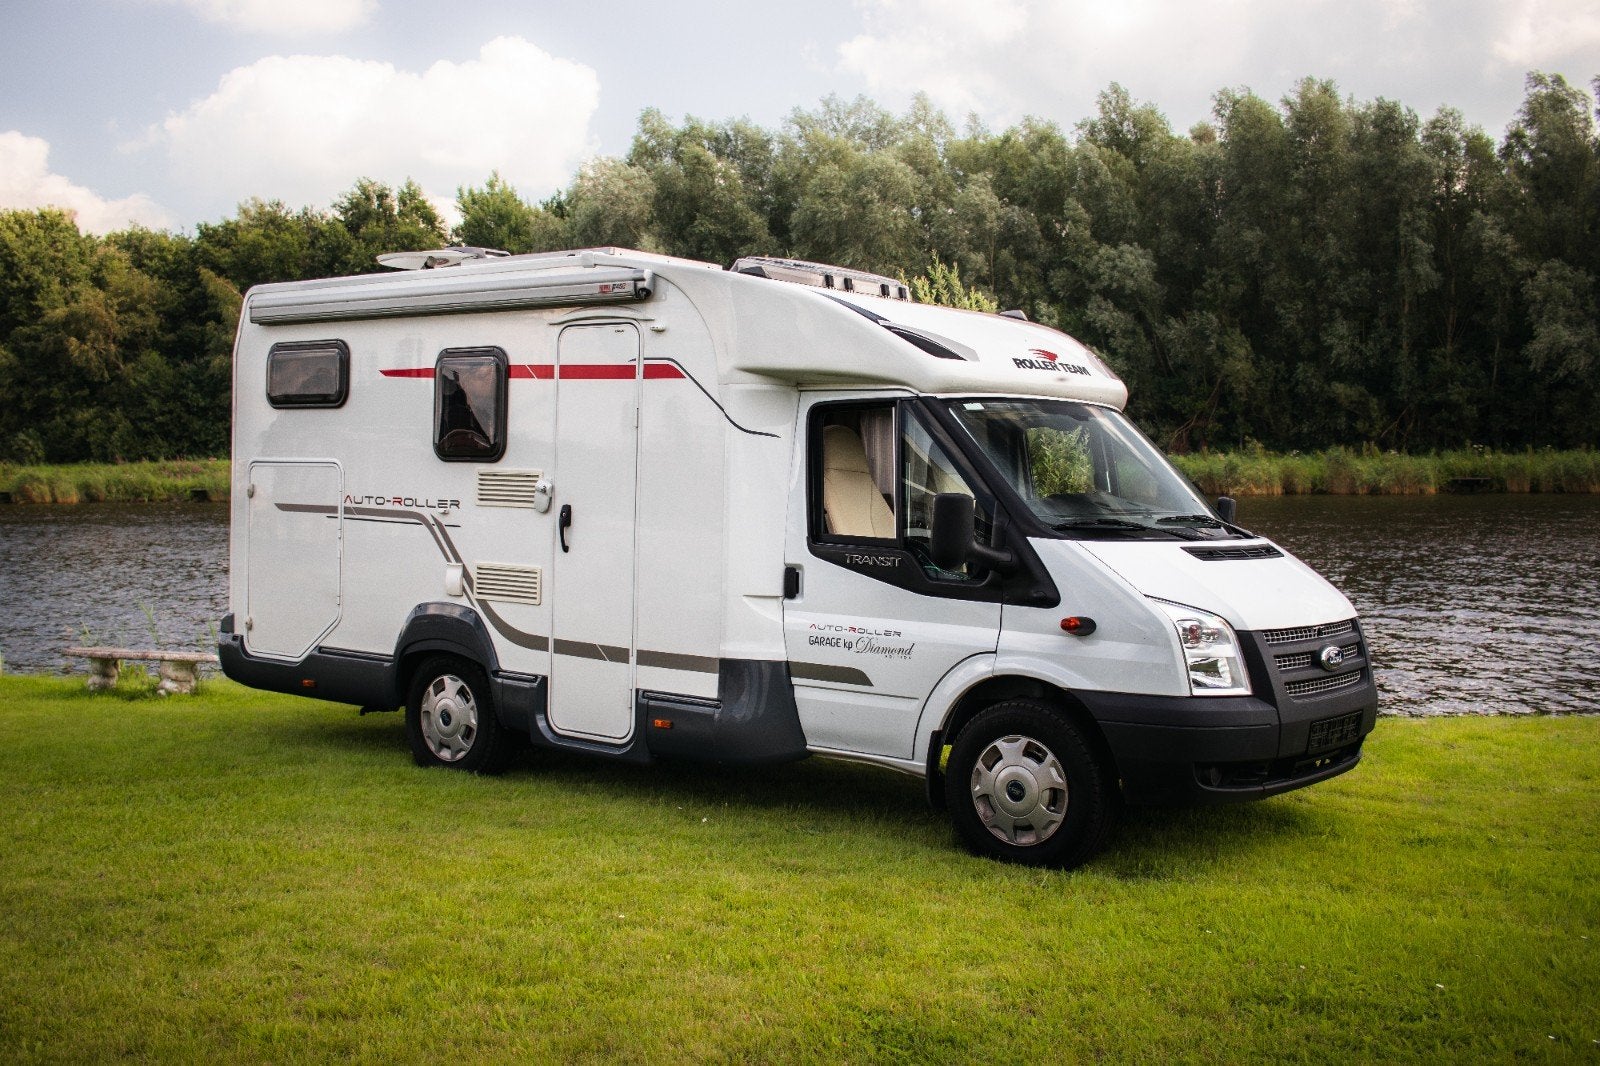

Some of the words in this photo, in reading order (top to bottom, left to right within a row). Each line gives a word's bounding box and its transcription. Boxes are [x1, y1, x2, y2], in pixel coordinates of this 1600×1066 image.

[1012, 357, 1061, 371] ROLLER
[1058, 362, 1091, 376] TEAM
[343, 494, 461, 509] AUTO-ROLLER
[845, 553, 902, 567] TRANSIT
[809, 623, 902, 637] AUTO-ROLLER
[808, 635, 842, 648] GARAGE
[843, 638, 853, 651] kp
[854, 636, 915, 654] Diamond
